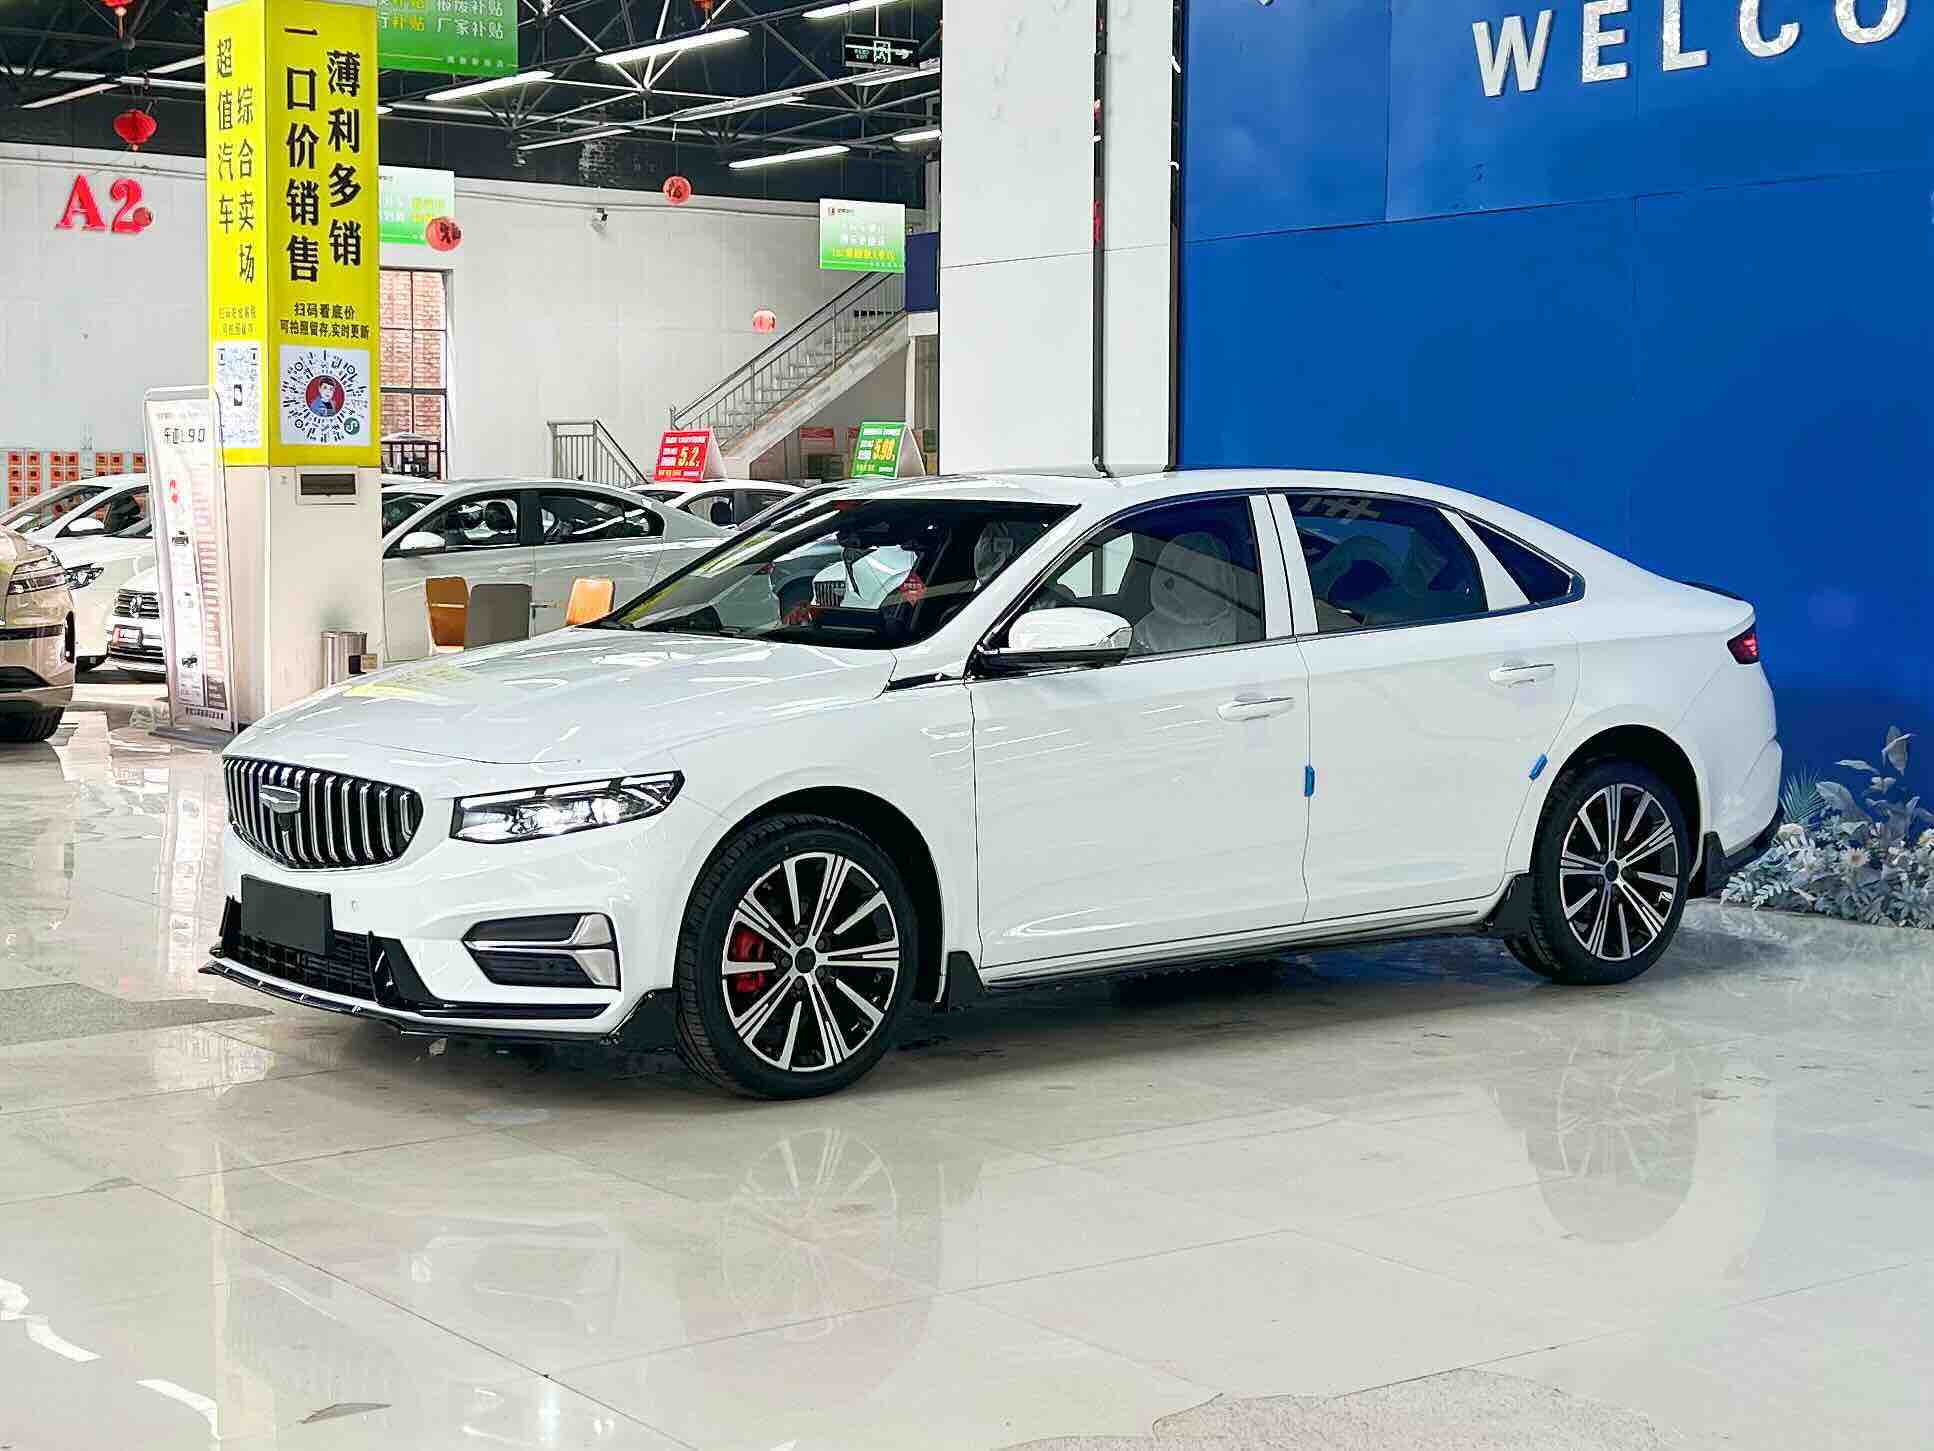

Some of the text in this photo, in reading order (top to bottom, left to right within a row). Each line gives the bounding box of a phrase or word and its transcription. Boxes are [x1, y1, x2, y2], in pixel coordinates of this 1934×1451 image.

[55, 174, 145, 233] A2
[216, 38, 234, 234] 超值汽车
[237, 84, 255, 283] 综合卖场
[284, 27, 320, 282] 一口价销售
[327, 50, 362, 266] 薄利多销
[294, 302, 355, 320] 扫码看底价
